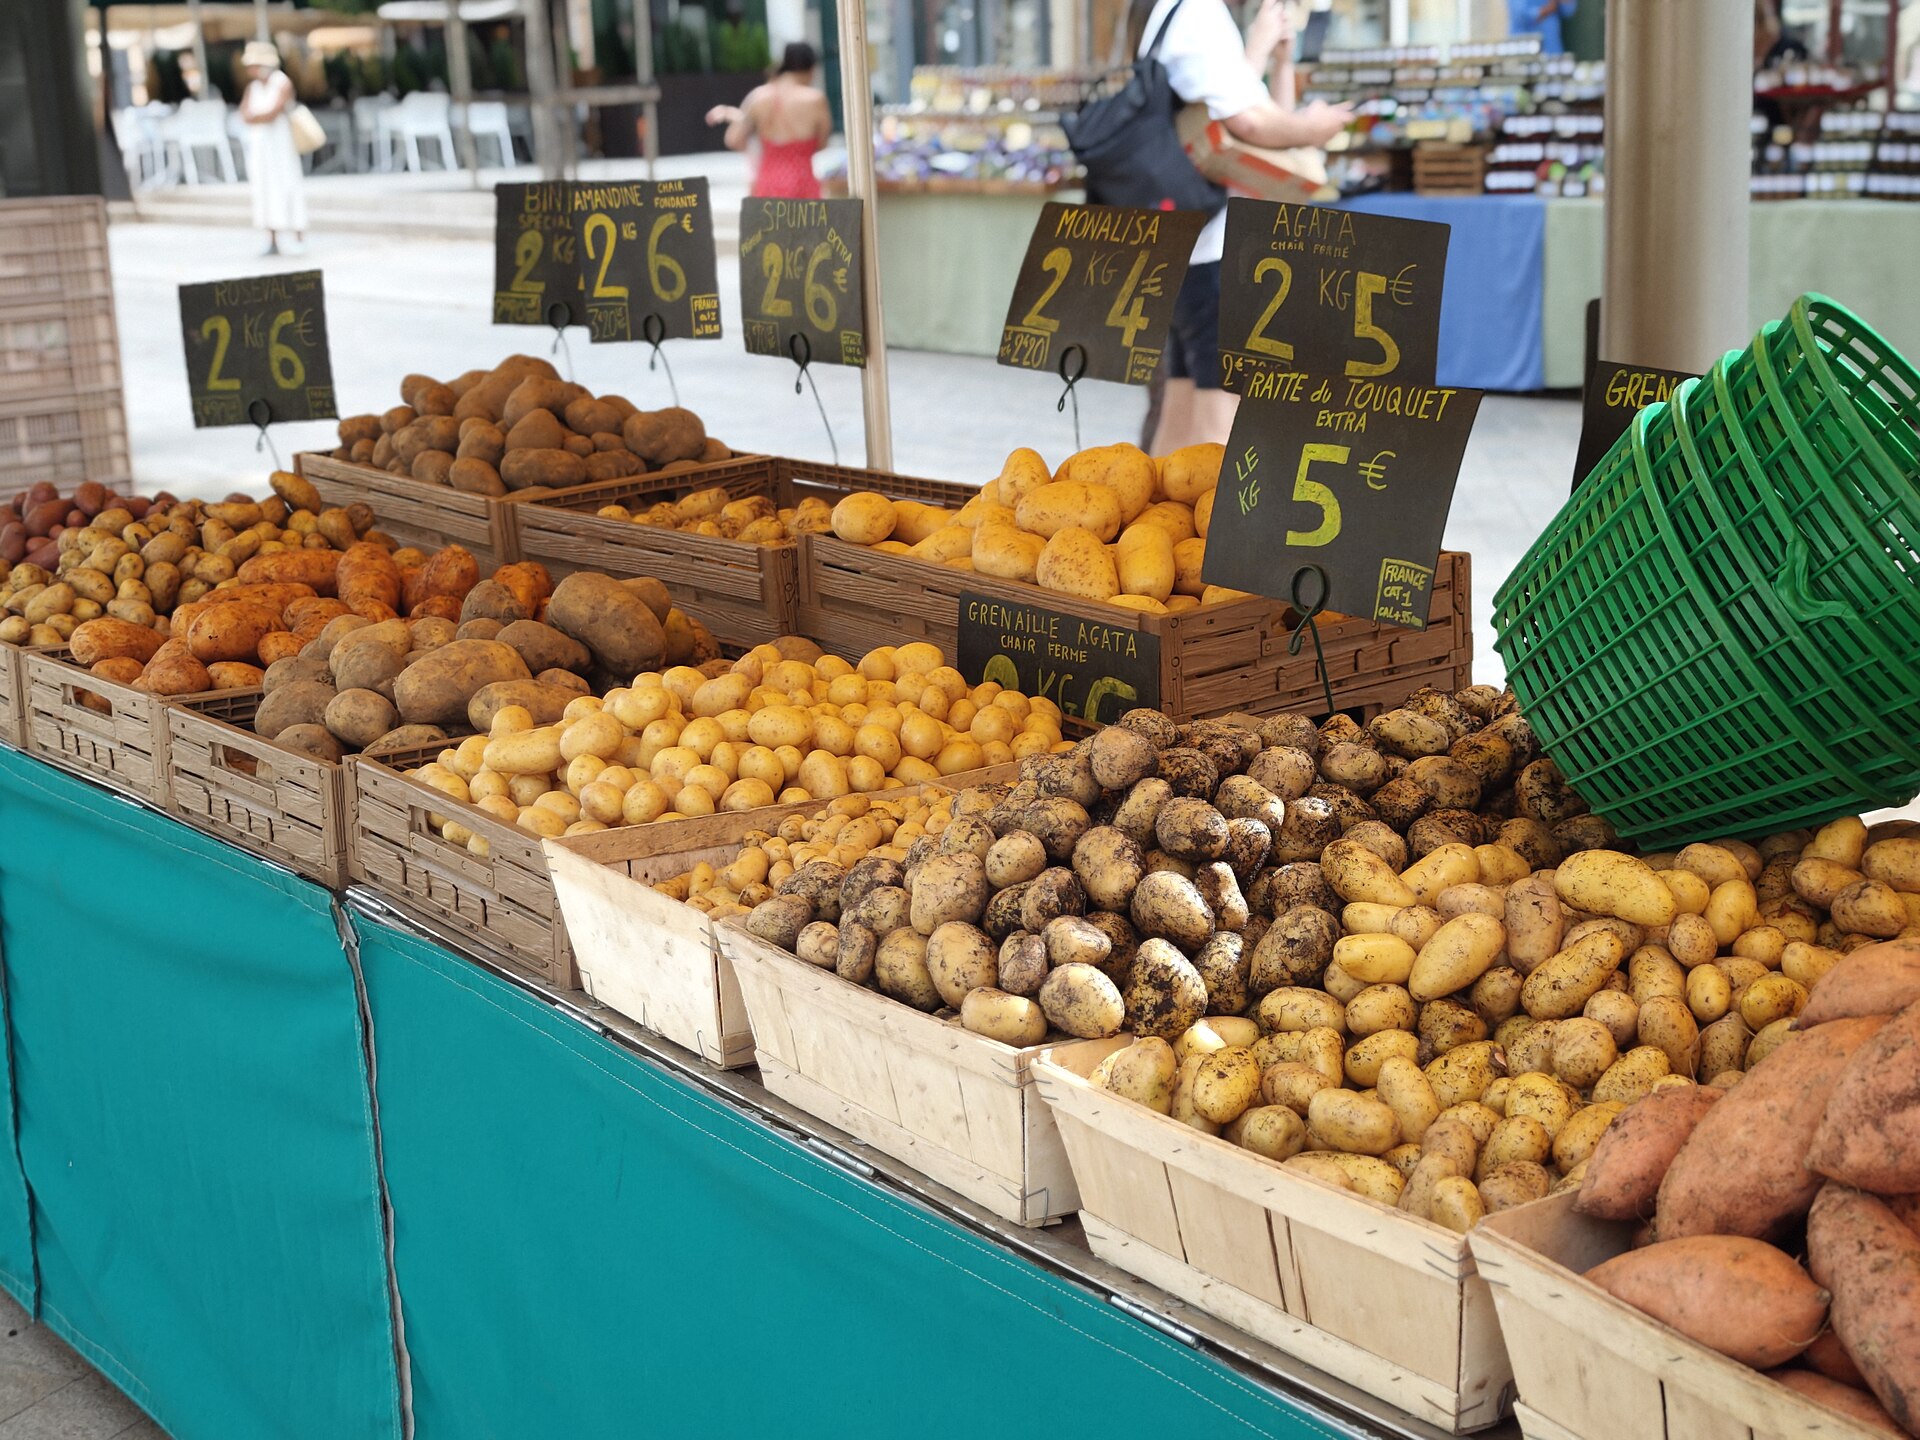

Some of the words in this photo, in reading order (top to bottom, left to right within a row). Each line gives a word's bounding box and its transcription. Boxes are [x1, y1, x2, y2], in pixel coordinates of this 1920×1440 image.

[574, 184, 644, 212] AMANDINE
[654, 194, 698, 209] FONDANTE
[761, 201, 828, 232] SPUNTA
[1272, 203, 1357, 246] AGATA
[510, 230, 546, 293] 2
[552, 235, 576, 265] KG
[584, 213, 630, 298] 2
[621, 222, 638, 241] KG
[826, 227, 853, 267] EXTRA
[761, 242, 793, 318] 2
[784, 246, 805, 280] KG
[1022, 247, 1073, 332] 2
[1083, 250, 1125, 287] KG
[1245, 257, 1294, 361] 2
[1319, 268, 1351, 311] KG
[201, 315, 242, 391] 2
[243, 311, 265, 349] KG
[1246, 371, 1309, 403] RATTE
[1310, 379, 1333, 405] du
[1344, 378, 1457, 422] TOUQUET
[1315, 409, 1368, 433] EXTRA
[1235, 445, 1260, 482] LE
[1237, 479, 1262, 516] KG
[1383, 586, 1404, 600] CAT
[1385, 564, 1428, 591] FRANCE
[1048, 642, 1088, 663] FERME
[1077, 622, 1138, 659] AGATA
